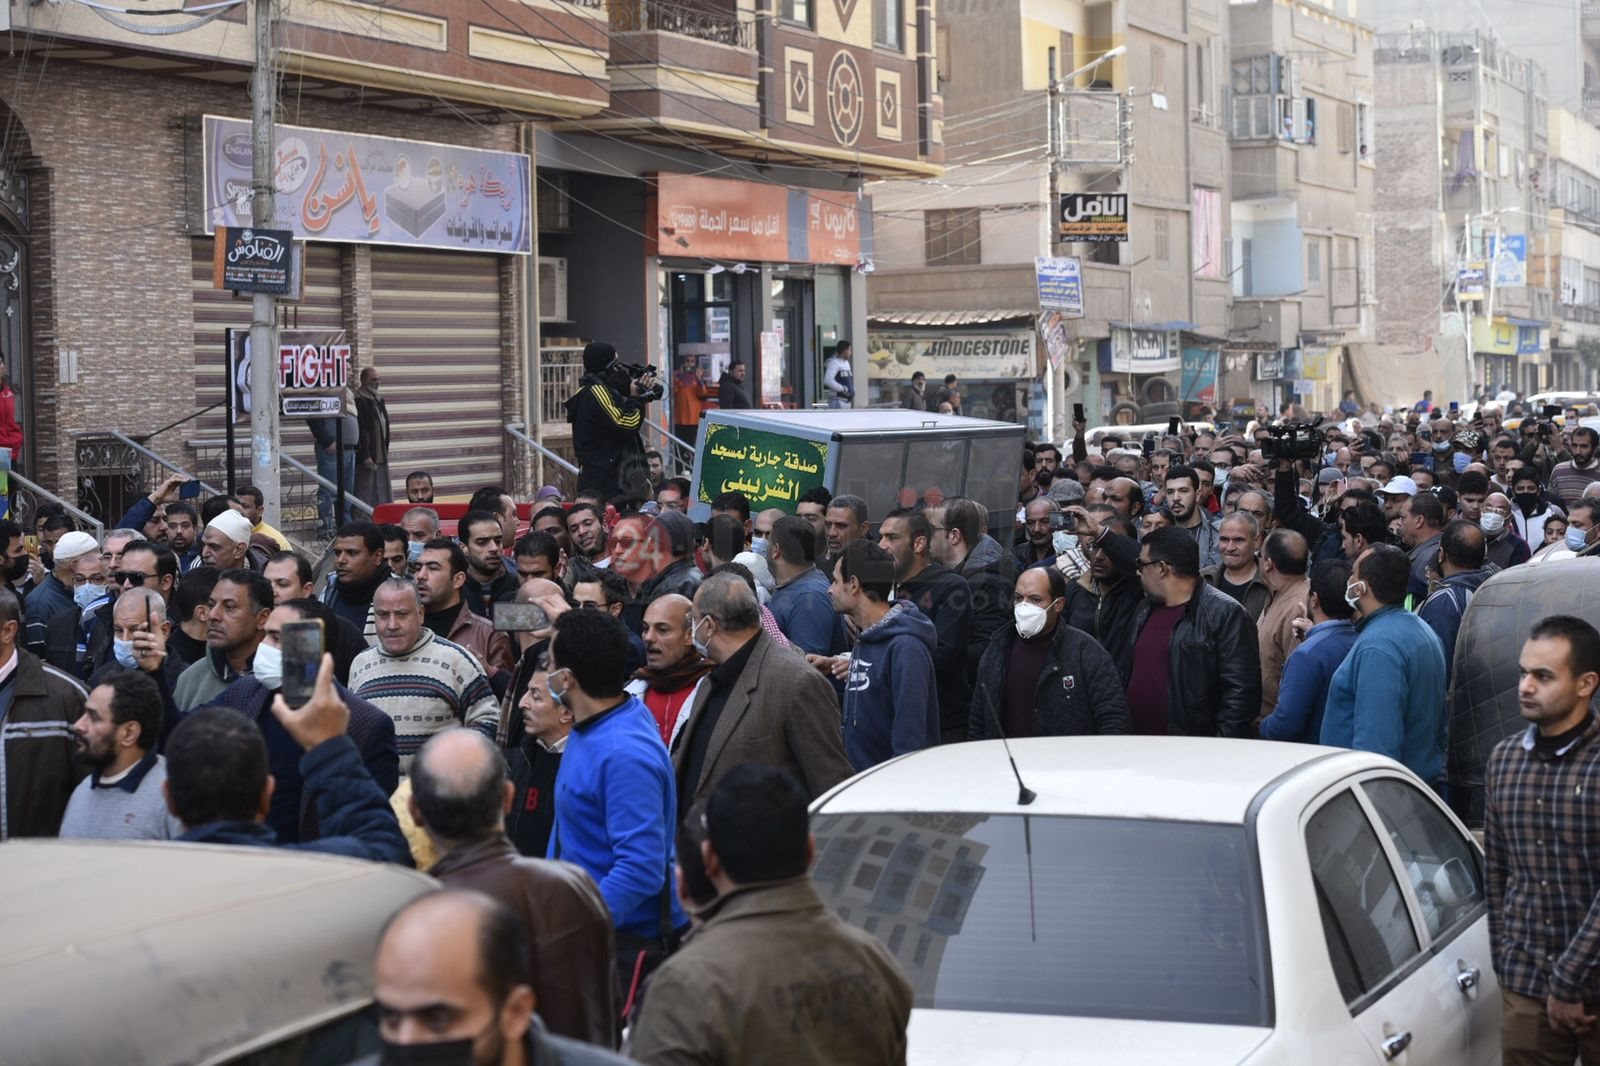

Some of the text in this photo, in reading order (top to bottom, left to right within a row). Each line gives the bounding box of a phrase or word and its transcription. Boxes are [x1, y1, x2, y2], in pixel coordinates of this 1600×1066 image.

[699, 208, 728, 235] الجملة
[728, 216, 751, 236] سعر
[922, 338, 1030, 358] BRIDGESTONE
[279, 344, 351, 388] FIGHT
[320, 400, 340, 412] CLUB
[710, 442, 818, 474] صدقة جارية لمسجد
[525, 787, 540, 812] B
